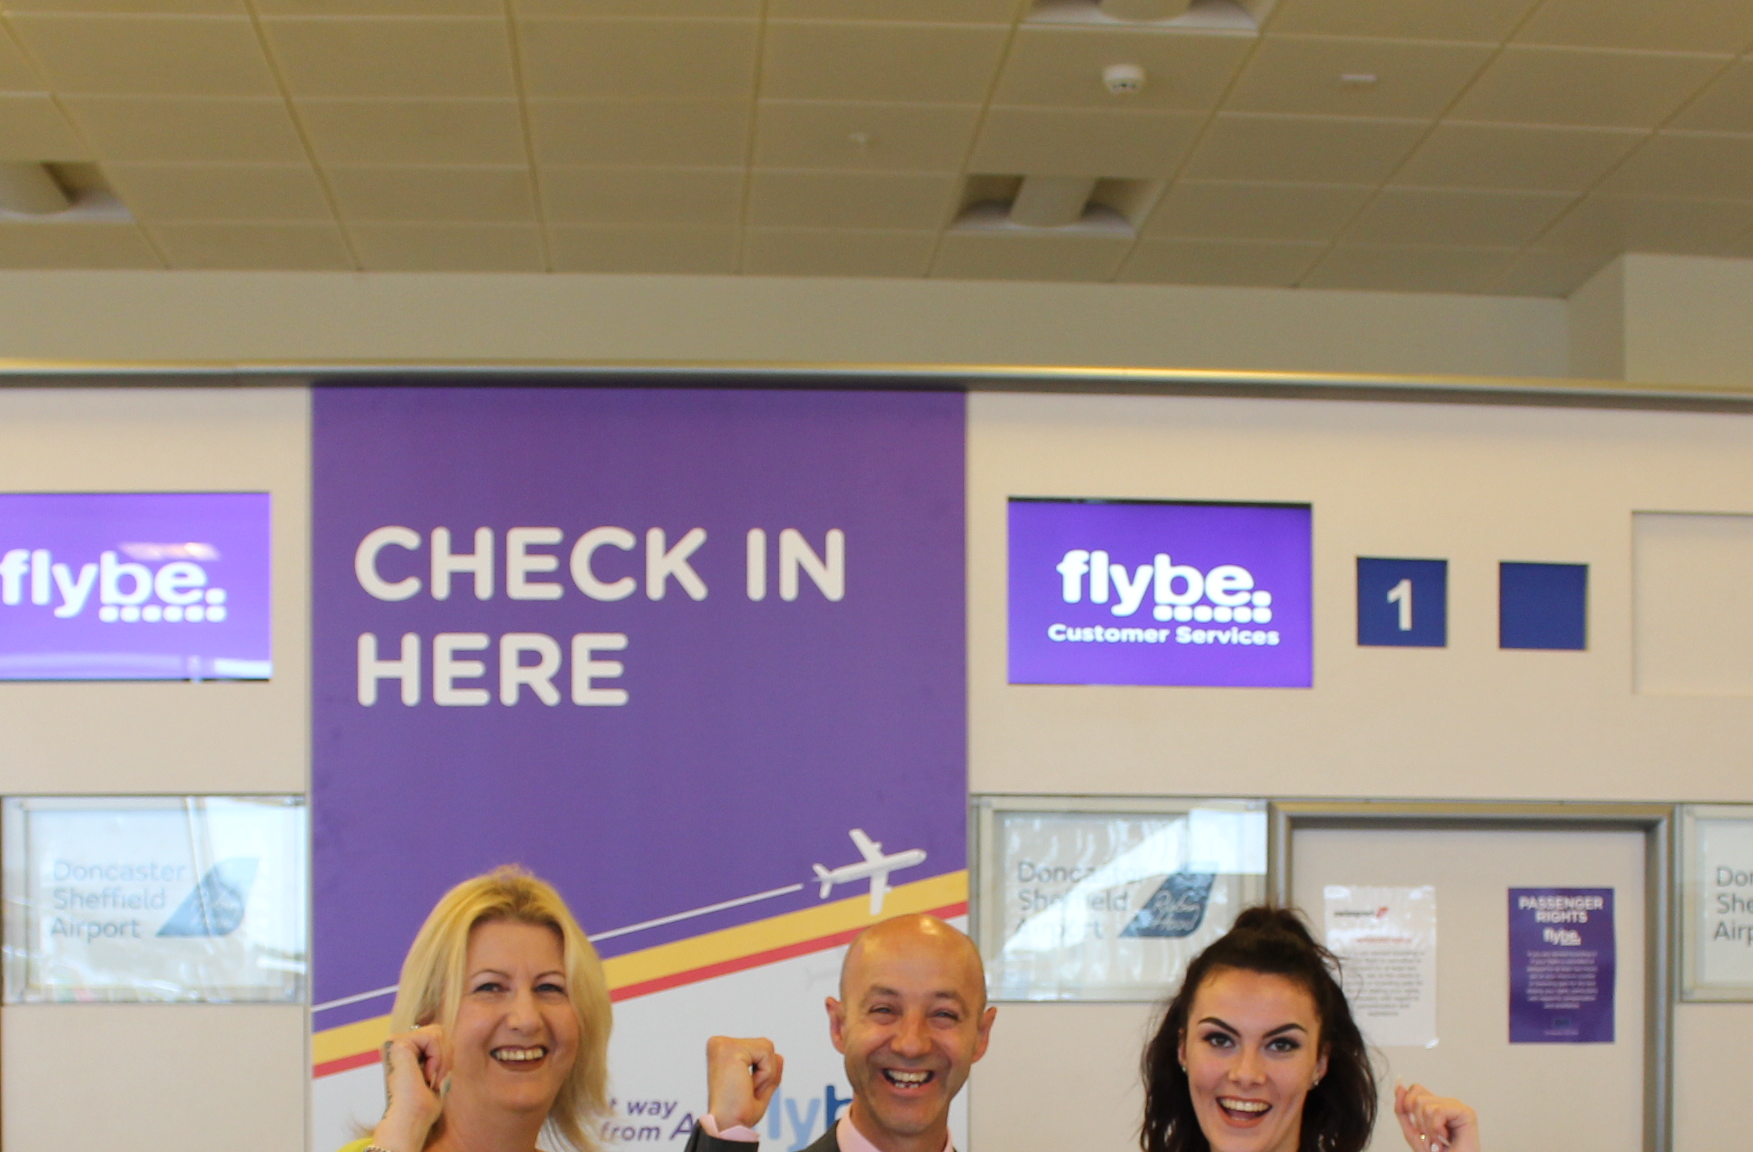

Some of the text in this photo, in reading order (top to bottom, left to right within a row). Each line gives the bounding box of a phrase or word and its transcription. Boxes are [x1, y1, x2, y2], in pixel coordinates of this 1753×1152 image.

[354, 525, 846, 602] CHECK IN
[1386, 577, 1413, 632] 1
[1047, 623, 1281, 646] Customer Services
[356, 632, 630, 707] HERE
[53, 859, 186, 882] Doncaster
[53, 887, 166, 911] Sheffield
[1518, 896, 1603, 910] PASSENGER
[1535, 911, 1588, 923] RIGHTS
[51, 917, 141, 943] Airport
[627, 1099, 678, 1120] way
[600, 1121, 661, 1142] from
